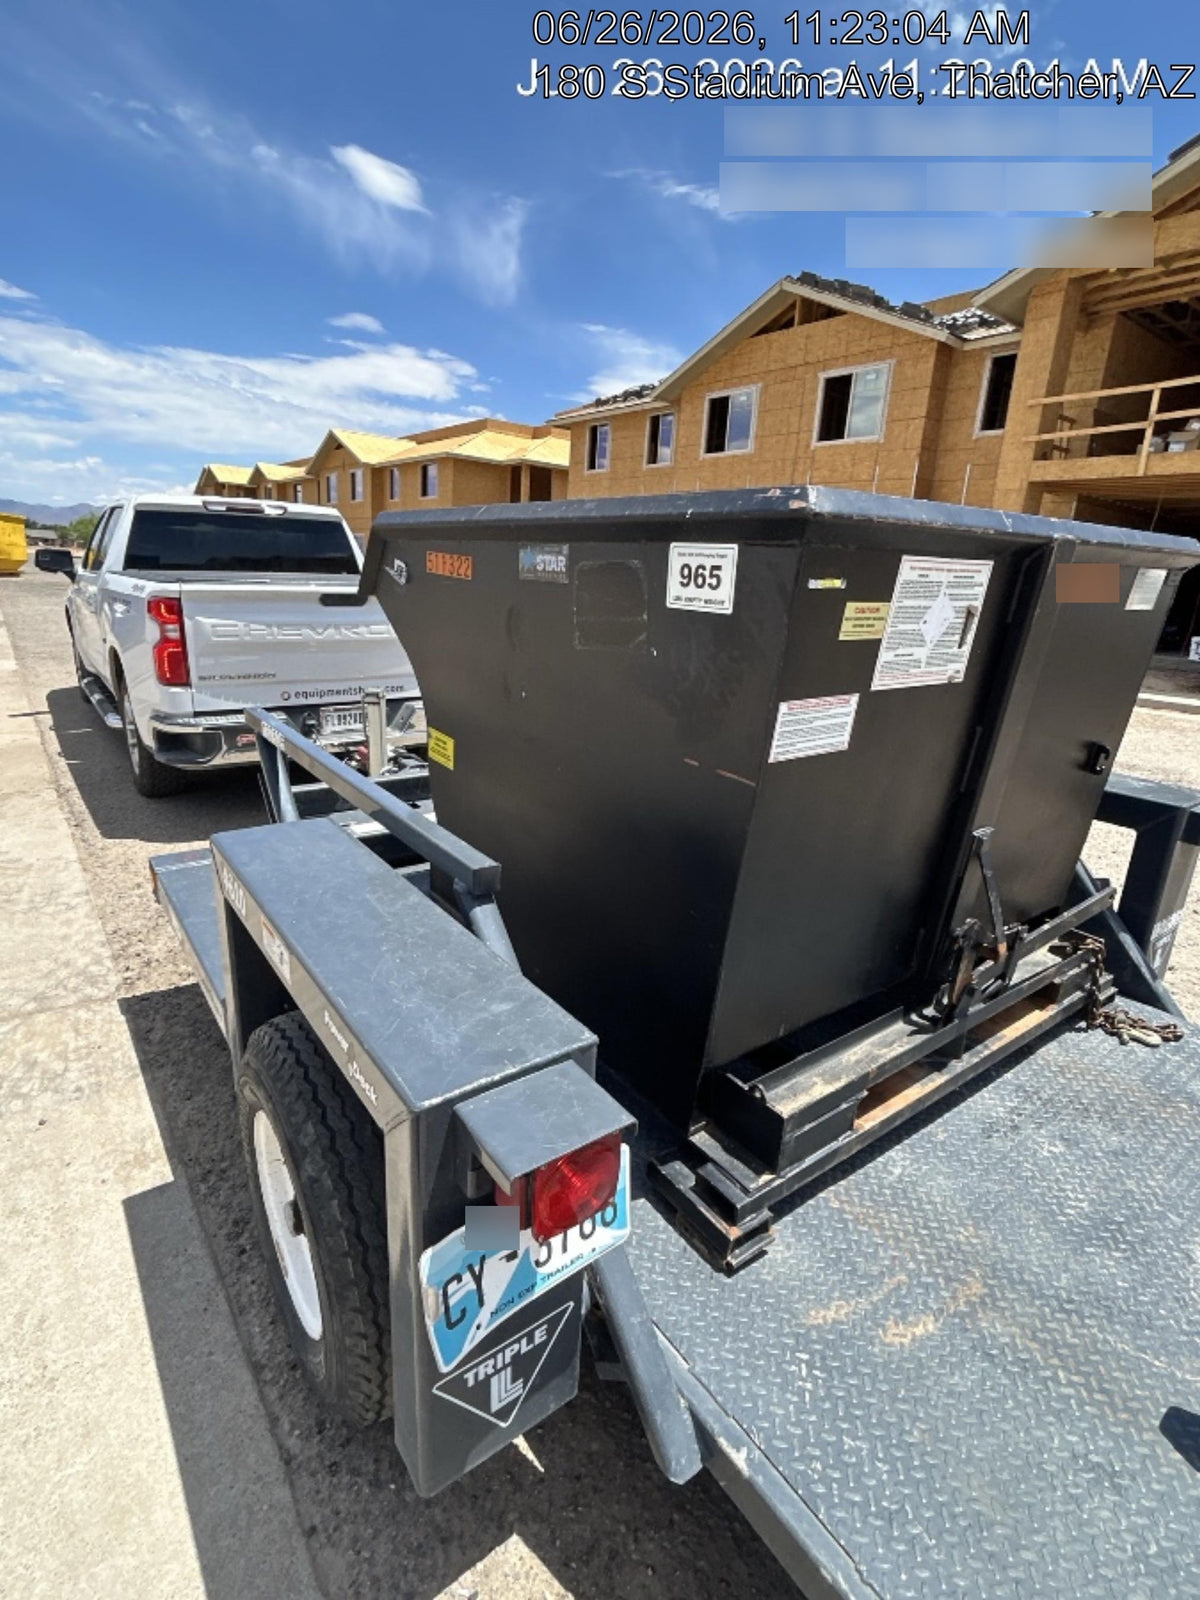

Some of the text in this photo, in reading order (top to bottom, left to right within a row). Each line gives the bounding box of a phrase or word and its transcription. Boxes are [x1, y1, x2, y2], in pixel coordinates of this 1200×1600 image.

[536, 554, 566, 573] STAR
[679, 563, 722, 591] 965
[463, 1323, 549, 1388] TRIPLE
